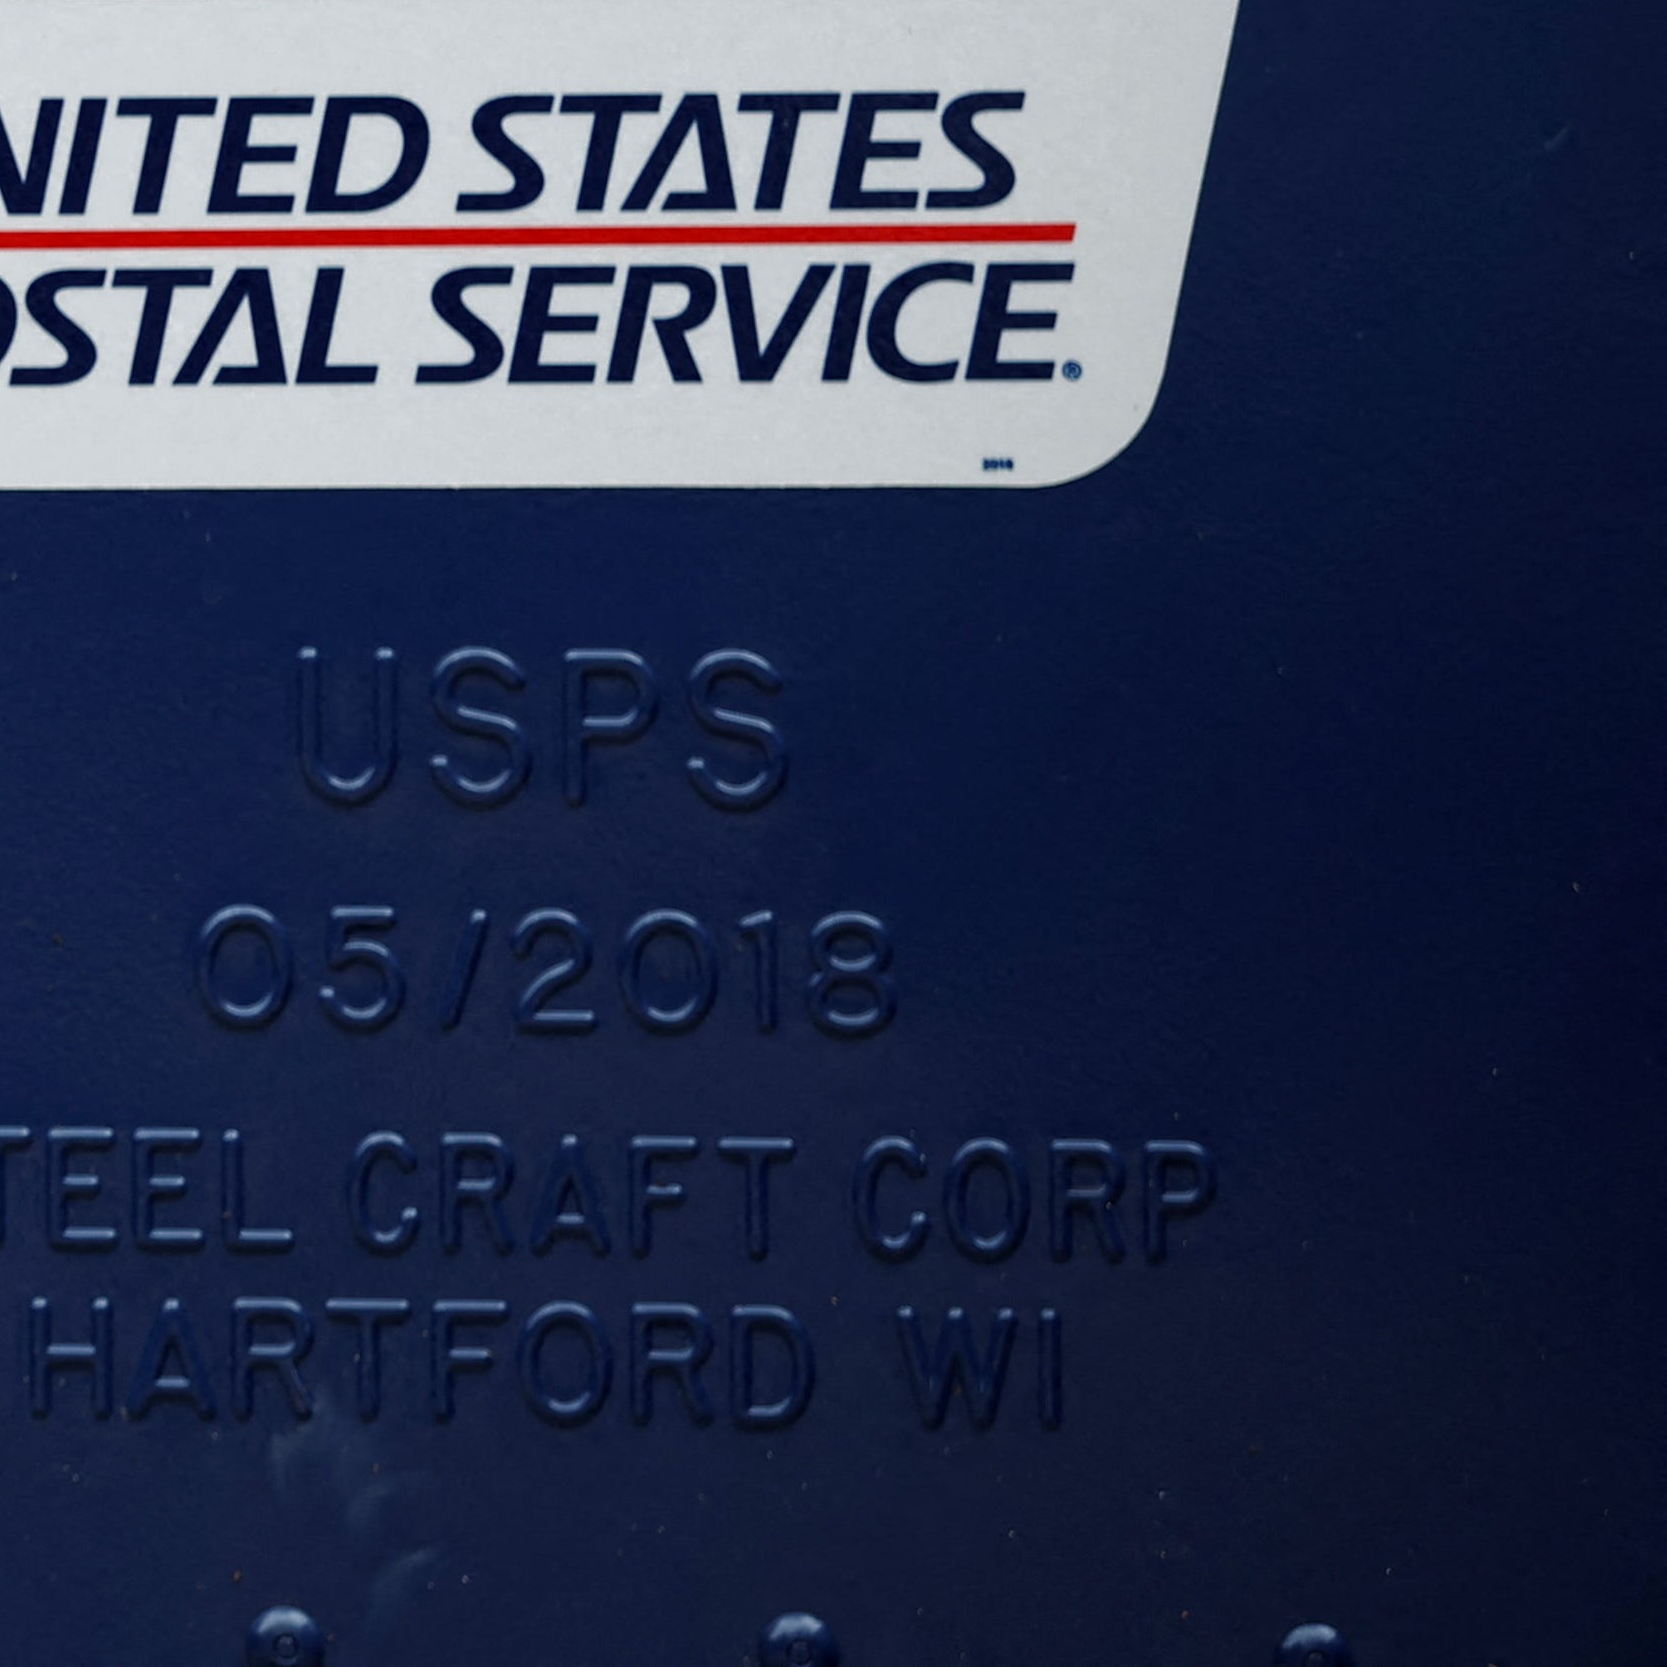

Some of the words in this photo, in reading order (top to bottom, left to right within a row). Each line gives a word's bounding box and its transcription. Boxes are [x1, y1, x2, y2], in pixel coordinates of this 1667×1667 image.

[456, 90, 1026, 213] STATES
[295, 644, 787, 810] USPS
[194, 902, 898, 1036] 05/2018
[343, 1129, 796, 1260] CRAFT
[852, 1135, 1218, 1262] CORP
[26, 1296, 814, 1428] HARTFORD
[898, 1306, 1065, 1428] WI
